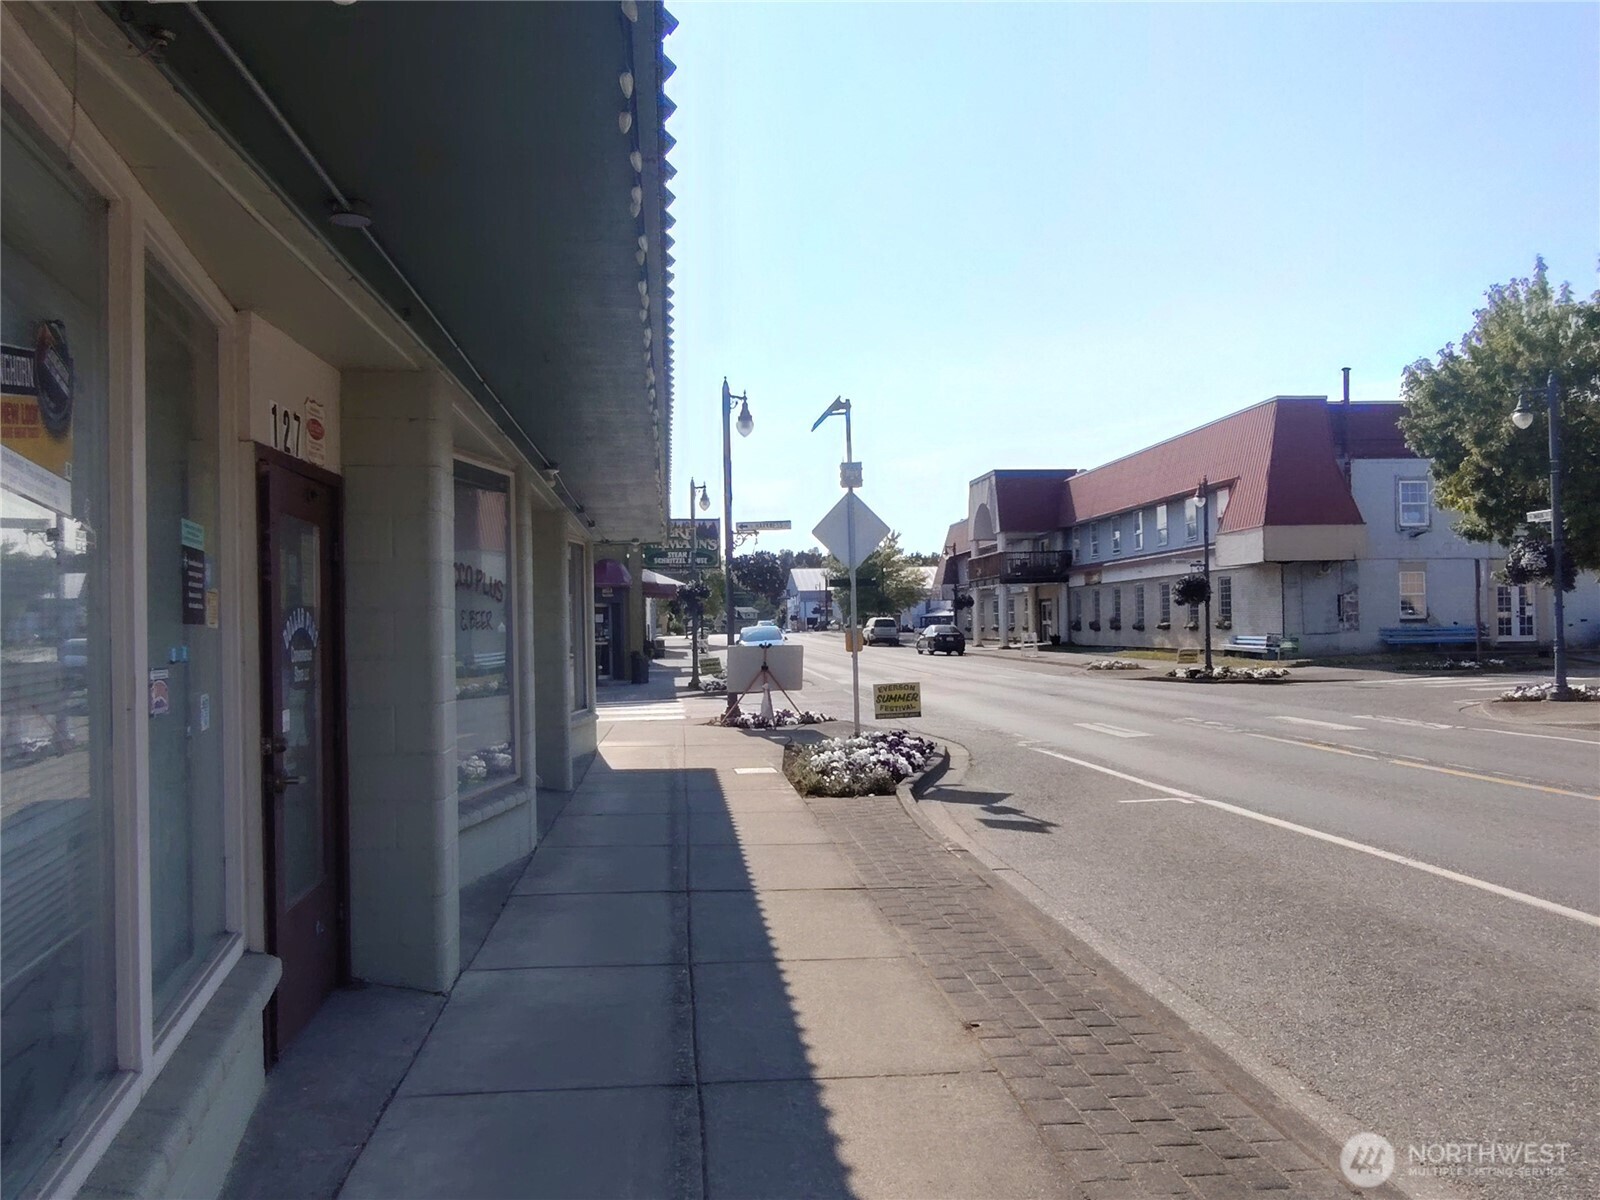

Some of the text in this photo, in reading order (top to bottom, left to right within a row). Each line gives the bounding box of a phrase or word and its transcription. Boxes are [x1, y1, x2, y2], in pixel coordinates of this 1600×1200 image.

[271, 403, 301, 457] 127
[476, 568, 504, 602] PLUS
[469, 609, 493, 631] BEER
[877, 684, 916, 693] EVERSON
[876, 692, 919, 704] SUMMER
[880, 704, 916, 712] FESTIVAL
